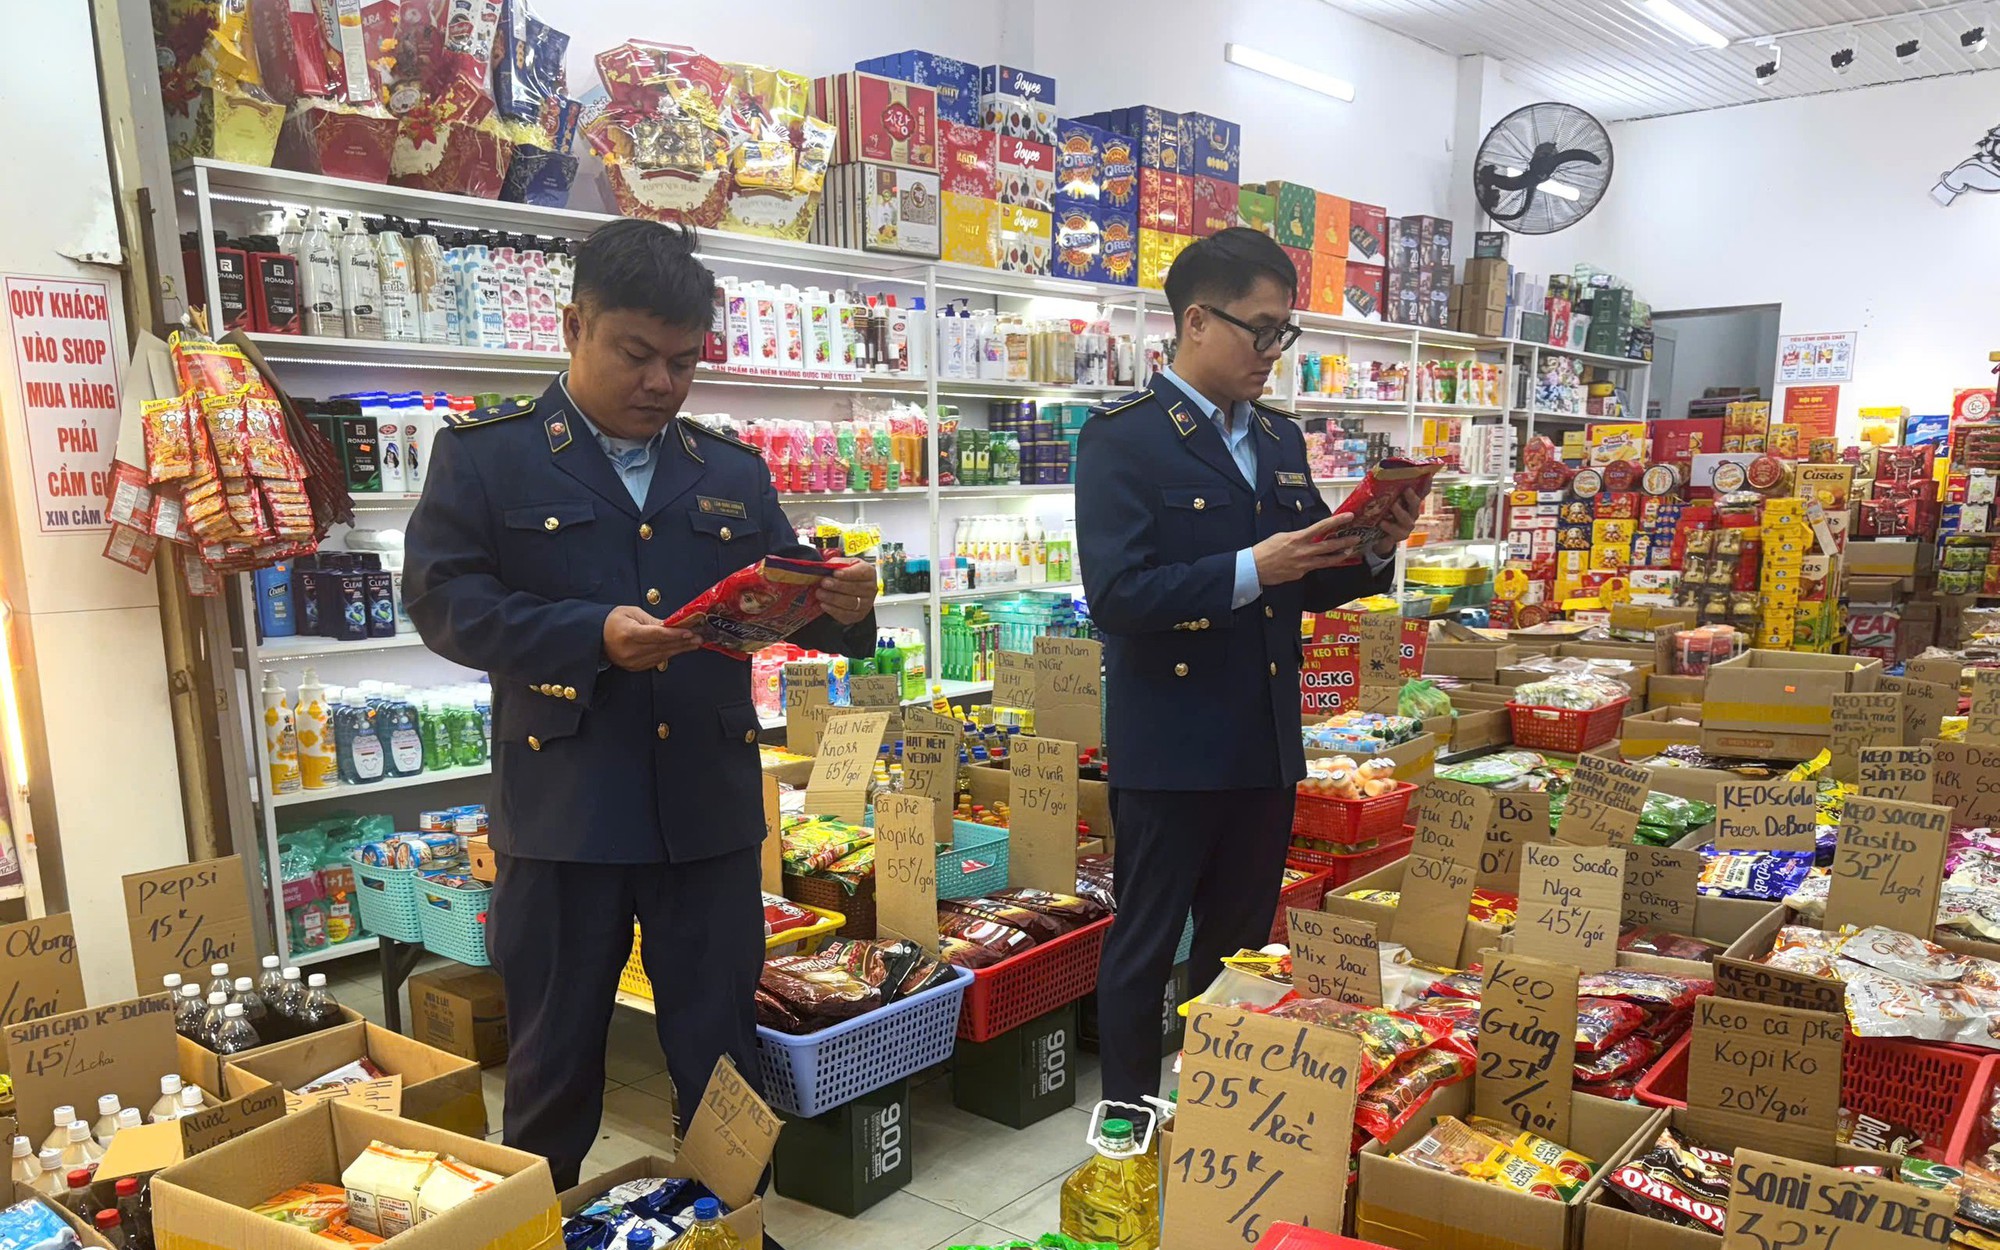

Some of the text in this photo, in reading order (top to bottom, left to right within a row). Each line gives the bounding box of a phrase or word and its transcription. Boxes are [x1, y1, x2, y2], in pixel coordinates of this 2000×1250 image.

[1014, 73, 1041, 96] Joyee
[1013, 141, 1040, 164] Joyee
[1063, 153, 1094, 168] OREO
[1104, 164, 1132, 177] OREO
[1013, 210, 1039, 232] Joyee
[1104, 240, 1132, 253] OREO
[309, 254, 330, 266] Beauty
[351, 257, 371, 270] Beauty
[265, 276, 294, 286] ROMANO
[382, 283, 405, 292] milk
[10, 286, 108, 321] QUÝ KHÁCH
[22, 331, 106, 365] VÀO SHOP
[779, 369, 801, 378] KHÔNG
[26, 378, 116, 410] MUA HÀNG
[57, 418, 99, 453] PHẢI
[347, 437, 376, 445] ROMANO
[48, 462, 87, 498] CẦM
[1802, 469, 1844, 481] Custas
[46, 505, 101, 526] XIN CẢM
[1801, 562, 1821, 572] tas
[1404, 620, 1420, 631] TẾT
[1065, 645, 1089, 657] Nam
[1313, 645, 1350, 660] KẸO TẾT
[1002, 673, 1021, 686] UMI
[1305, 672, 1353, 687] 0.5KG
[1306, 693, 1340, 707] 1 KG
[935, 717, 955, 732] Hoa
[905, 735, 922, 751] HẠT
[1037, 741, 1061, 761] phê
[907, 752, 942, 764] VEDAN
[1861, 750, 1893, 767] KẸO
[1580, 755, 1650, 784] KẸO SOCOLA
[1900, 764, 1927, 781] BÒ
[1424, 781, 1475, 807] Socola
[1613, 779, 1641, 796] TAN
[895, 801, 919, 819] phê
[1500, 797, 1533, 822] Bò
[1842, 803, 1946, 832] KẸO SOCOLA
[1842, 825, 1917, 853] Pasito
[1528, 846, 1619, 878] Kẹo Socola
[1651, 852, 1682, 868] Sâm
[887, 857, 935, 893] 55K/gói
[1411, 856, 1468, 889] 30K/gói
[1543, 879, 1582, 907] Nga
[1289, 911, 1378, 950] Kẹo Socola
[1537, 907, 1606, 948] 45K/gói
[6, 925, 78, 965] Olong
[1295, 943, 1326, 966] Mix
[1486, 960, 1554, 1005] Kẹo
[1718, 964, 1771, 987] KẸO
[52, 1015, 90, 1036] GẠO
[1702, 1002, 1748, 1034] Kẹo
[1802, 1020, 1844, 1047] phê
[1047, 1028, 1066, 1092] 900
[1260, 1026, 1349, 1090] chua
[241, 1094, 279, 1116] Cam
[714, 1062, 777, 1138] KẸO FRES
[1719, 1084, 1809, 1123] 20K/gói
[881, 1102, 902, 1174] 900
